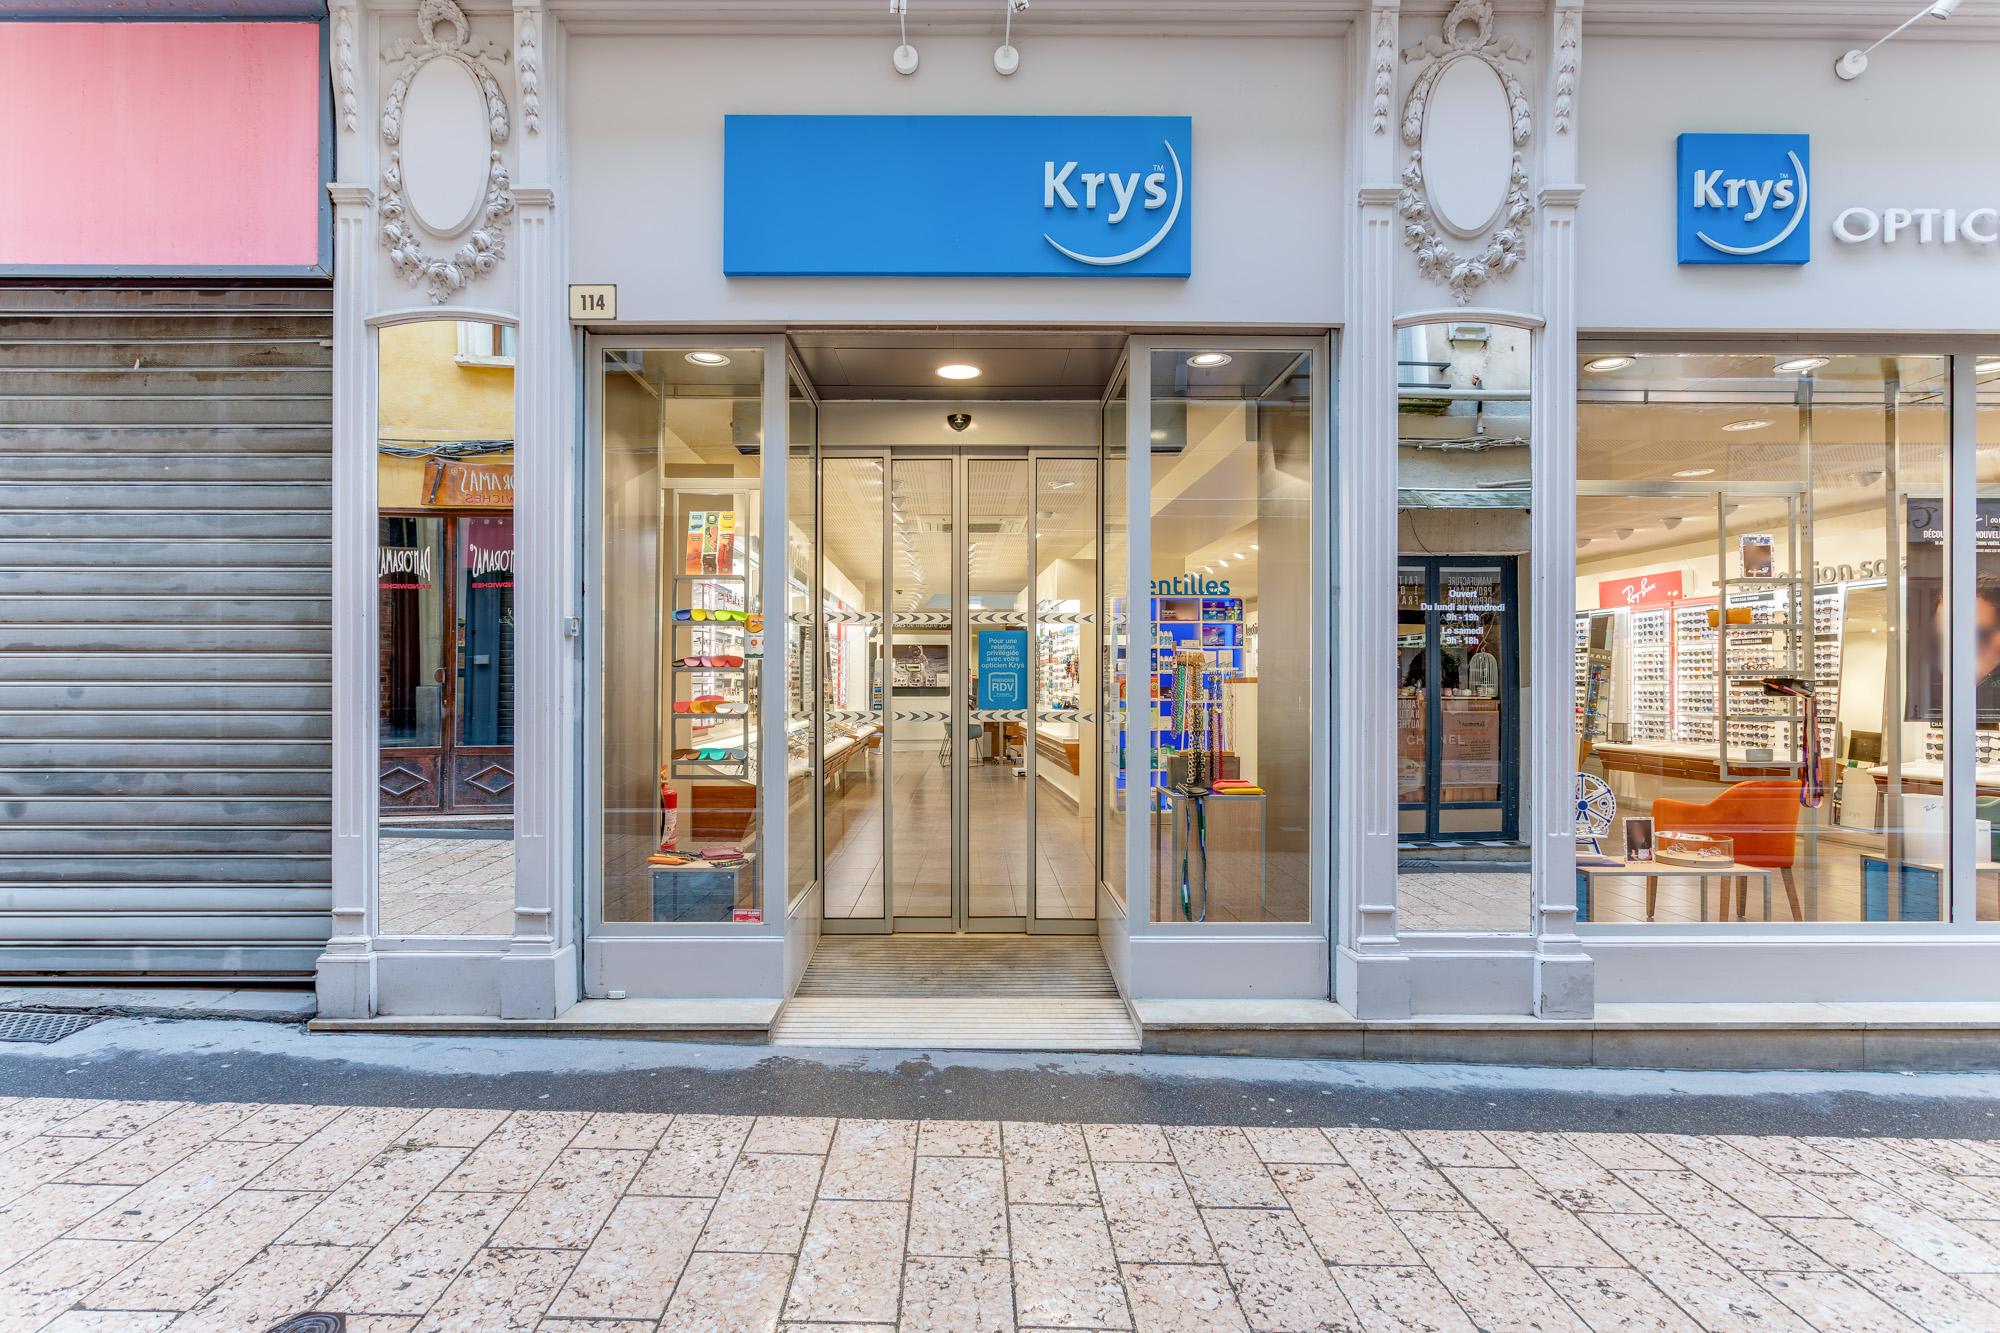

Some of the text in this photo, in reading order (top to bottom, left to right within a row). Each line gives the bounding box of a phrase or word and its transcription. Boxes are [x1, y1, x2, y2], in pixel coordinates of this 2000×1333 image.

[1043, 161, 1168, 224] Krys
[1693, 169, 1795, 222] Krys
[1832, 207, 1998, 243] OPTIC
[580, 294, 606, 311] 114
[1448, 589, 1478, 598] Ouvert
[1420, 603, 1433, 611] Du
[1434, 603, 1455, 611] lundi
[1468, 603, 1505, 612] vendredi
[1446, 613, 1457, 621] 9h
[1465, 613, 1479, 621] 19h
[1442, 627, 1484, 635] Le samedi
[1446, 637, 1457, 645] 9h
[1465, 637, 1479, 645] 18h
[992, 682, 1014, 691] RDV
[1406, 734, 1466, 745] CHNEL
